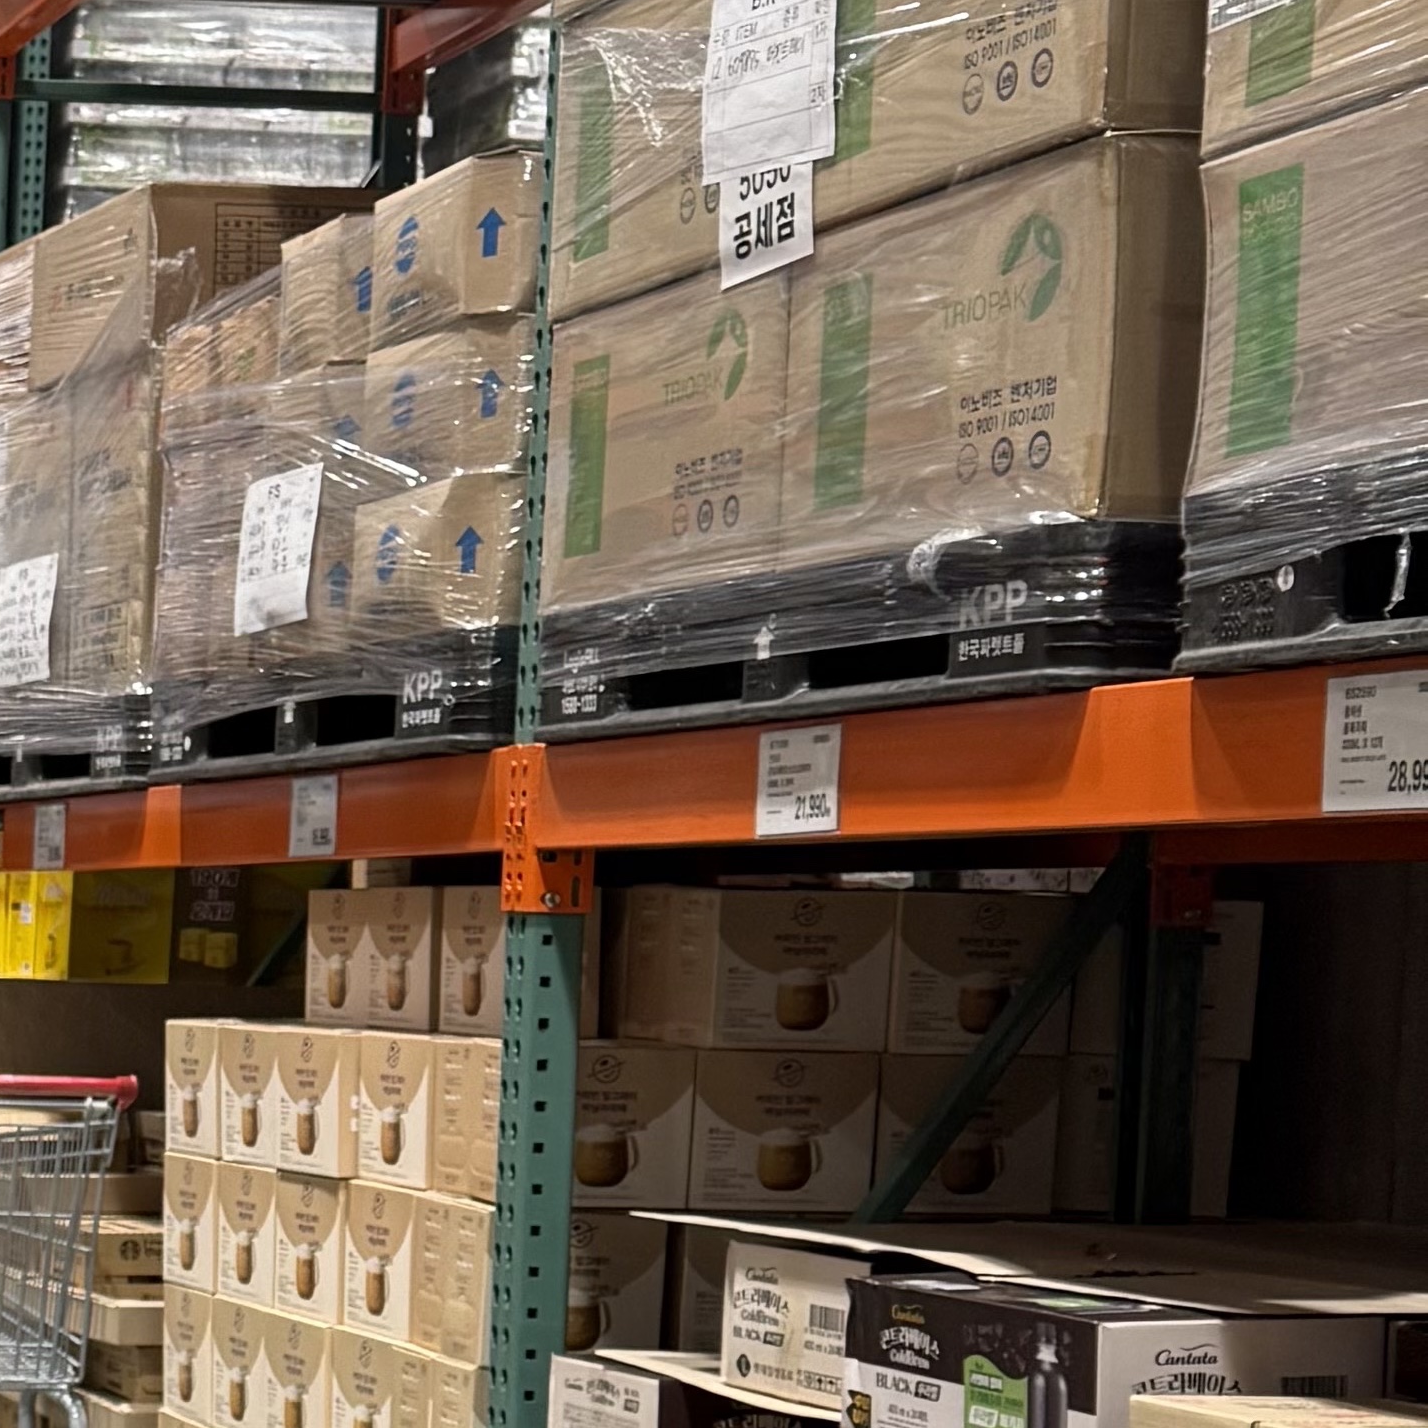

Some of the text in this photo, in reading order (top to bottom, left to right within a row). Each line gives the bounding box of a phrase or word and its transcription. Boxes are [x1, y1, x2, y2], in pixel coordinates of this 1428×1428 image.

[735, 22, 759, 42] ITEM
[733, 192, 796, 260] 공세점
[942, 281, 1027, 330] TRIOPAK
[960, 375, 1058, 414] 이노비즈 벤처기업
[958, 421, 974, 439] ISO
[1008, 401, 1056, 429] ISO14001
[959, 580, 1028, 630] KPP
[957, 632, 1025, 661] 한국파렛트풀
[402, 669, 444, 705] KPP
[732, 1325, 762, 1343] BLACK
[1155, 1343, 1220, 1367] Cantata
[875, 1372, 914, 1397] BLACK
